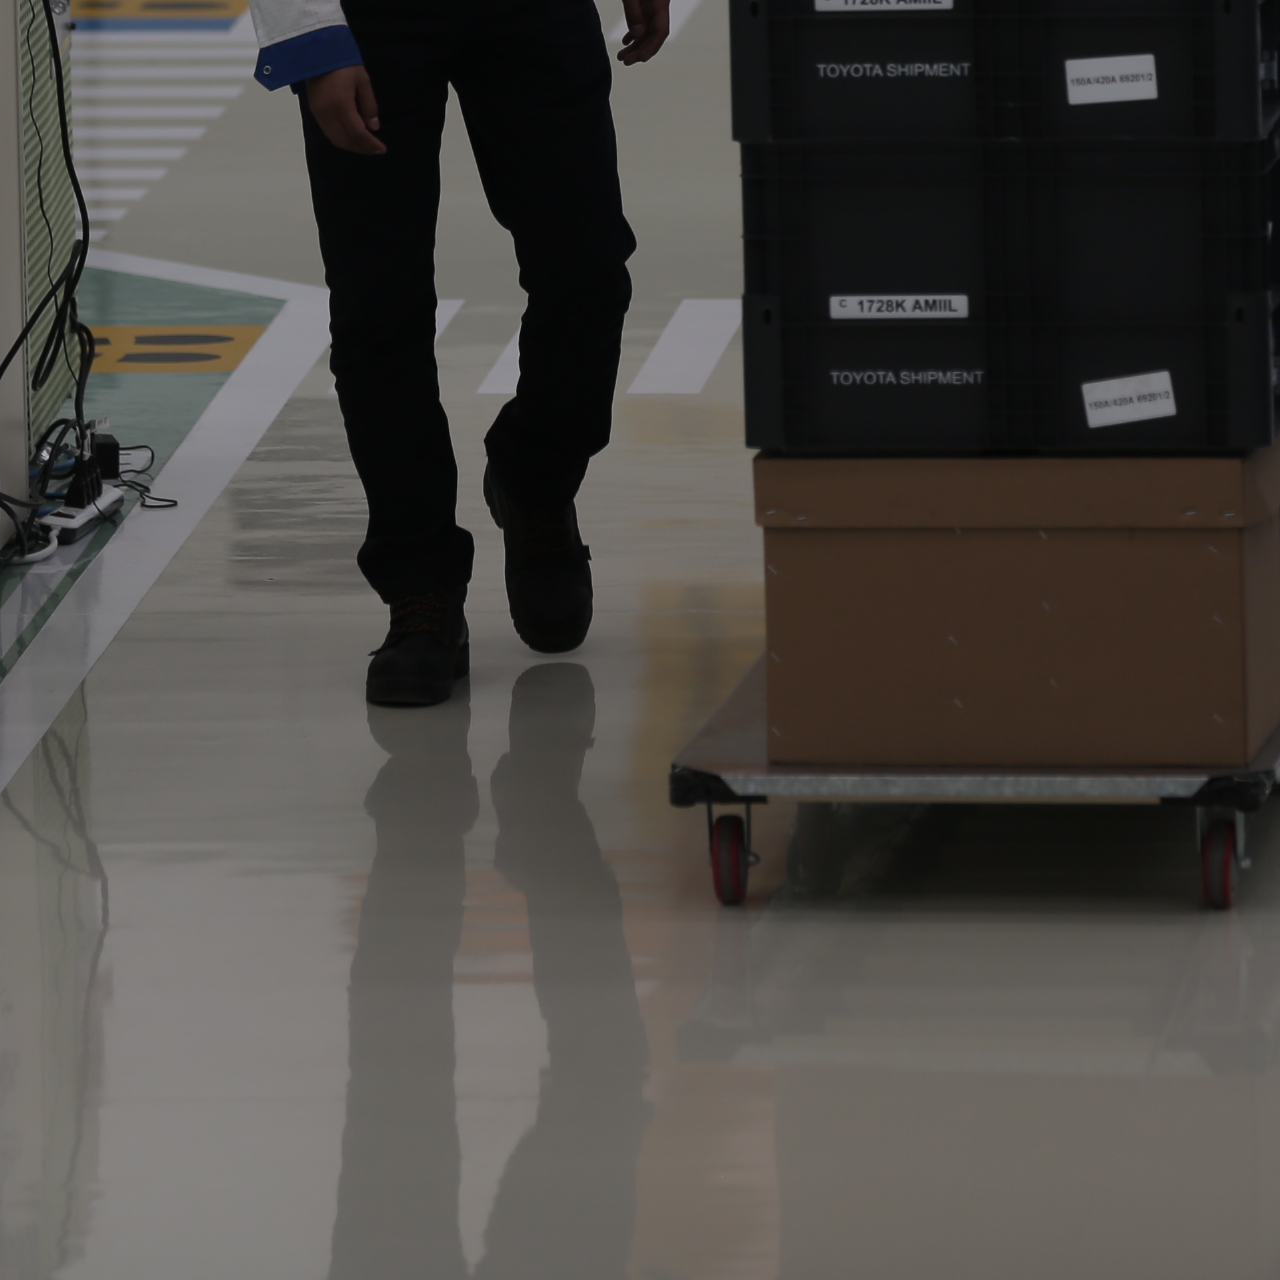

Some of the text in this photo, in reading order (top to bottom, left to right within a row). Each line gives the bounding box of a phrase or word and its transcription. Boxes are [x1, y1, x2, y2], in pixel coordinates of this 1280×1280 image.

[816, 62, 972, 78] TOYOTA SHIPMENT
[858, 299, 907, 313] 1728K
[830, 370, 984, 386] TOYOTA SHIPMENT
